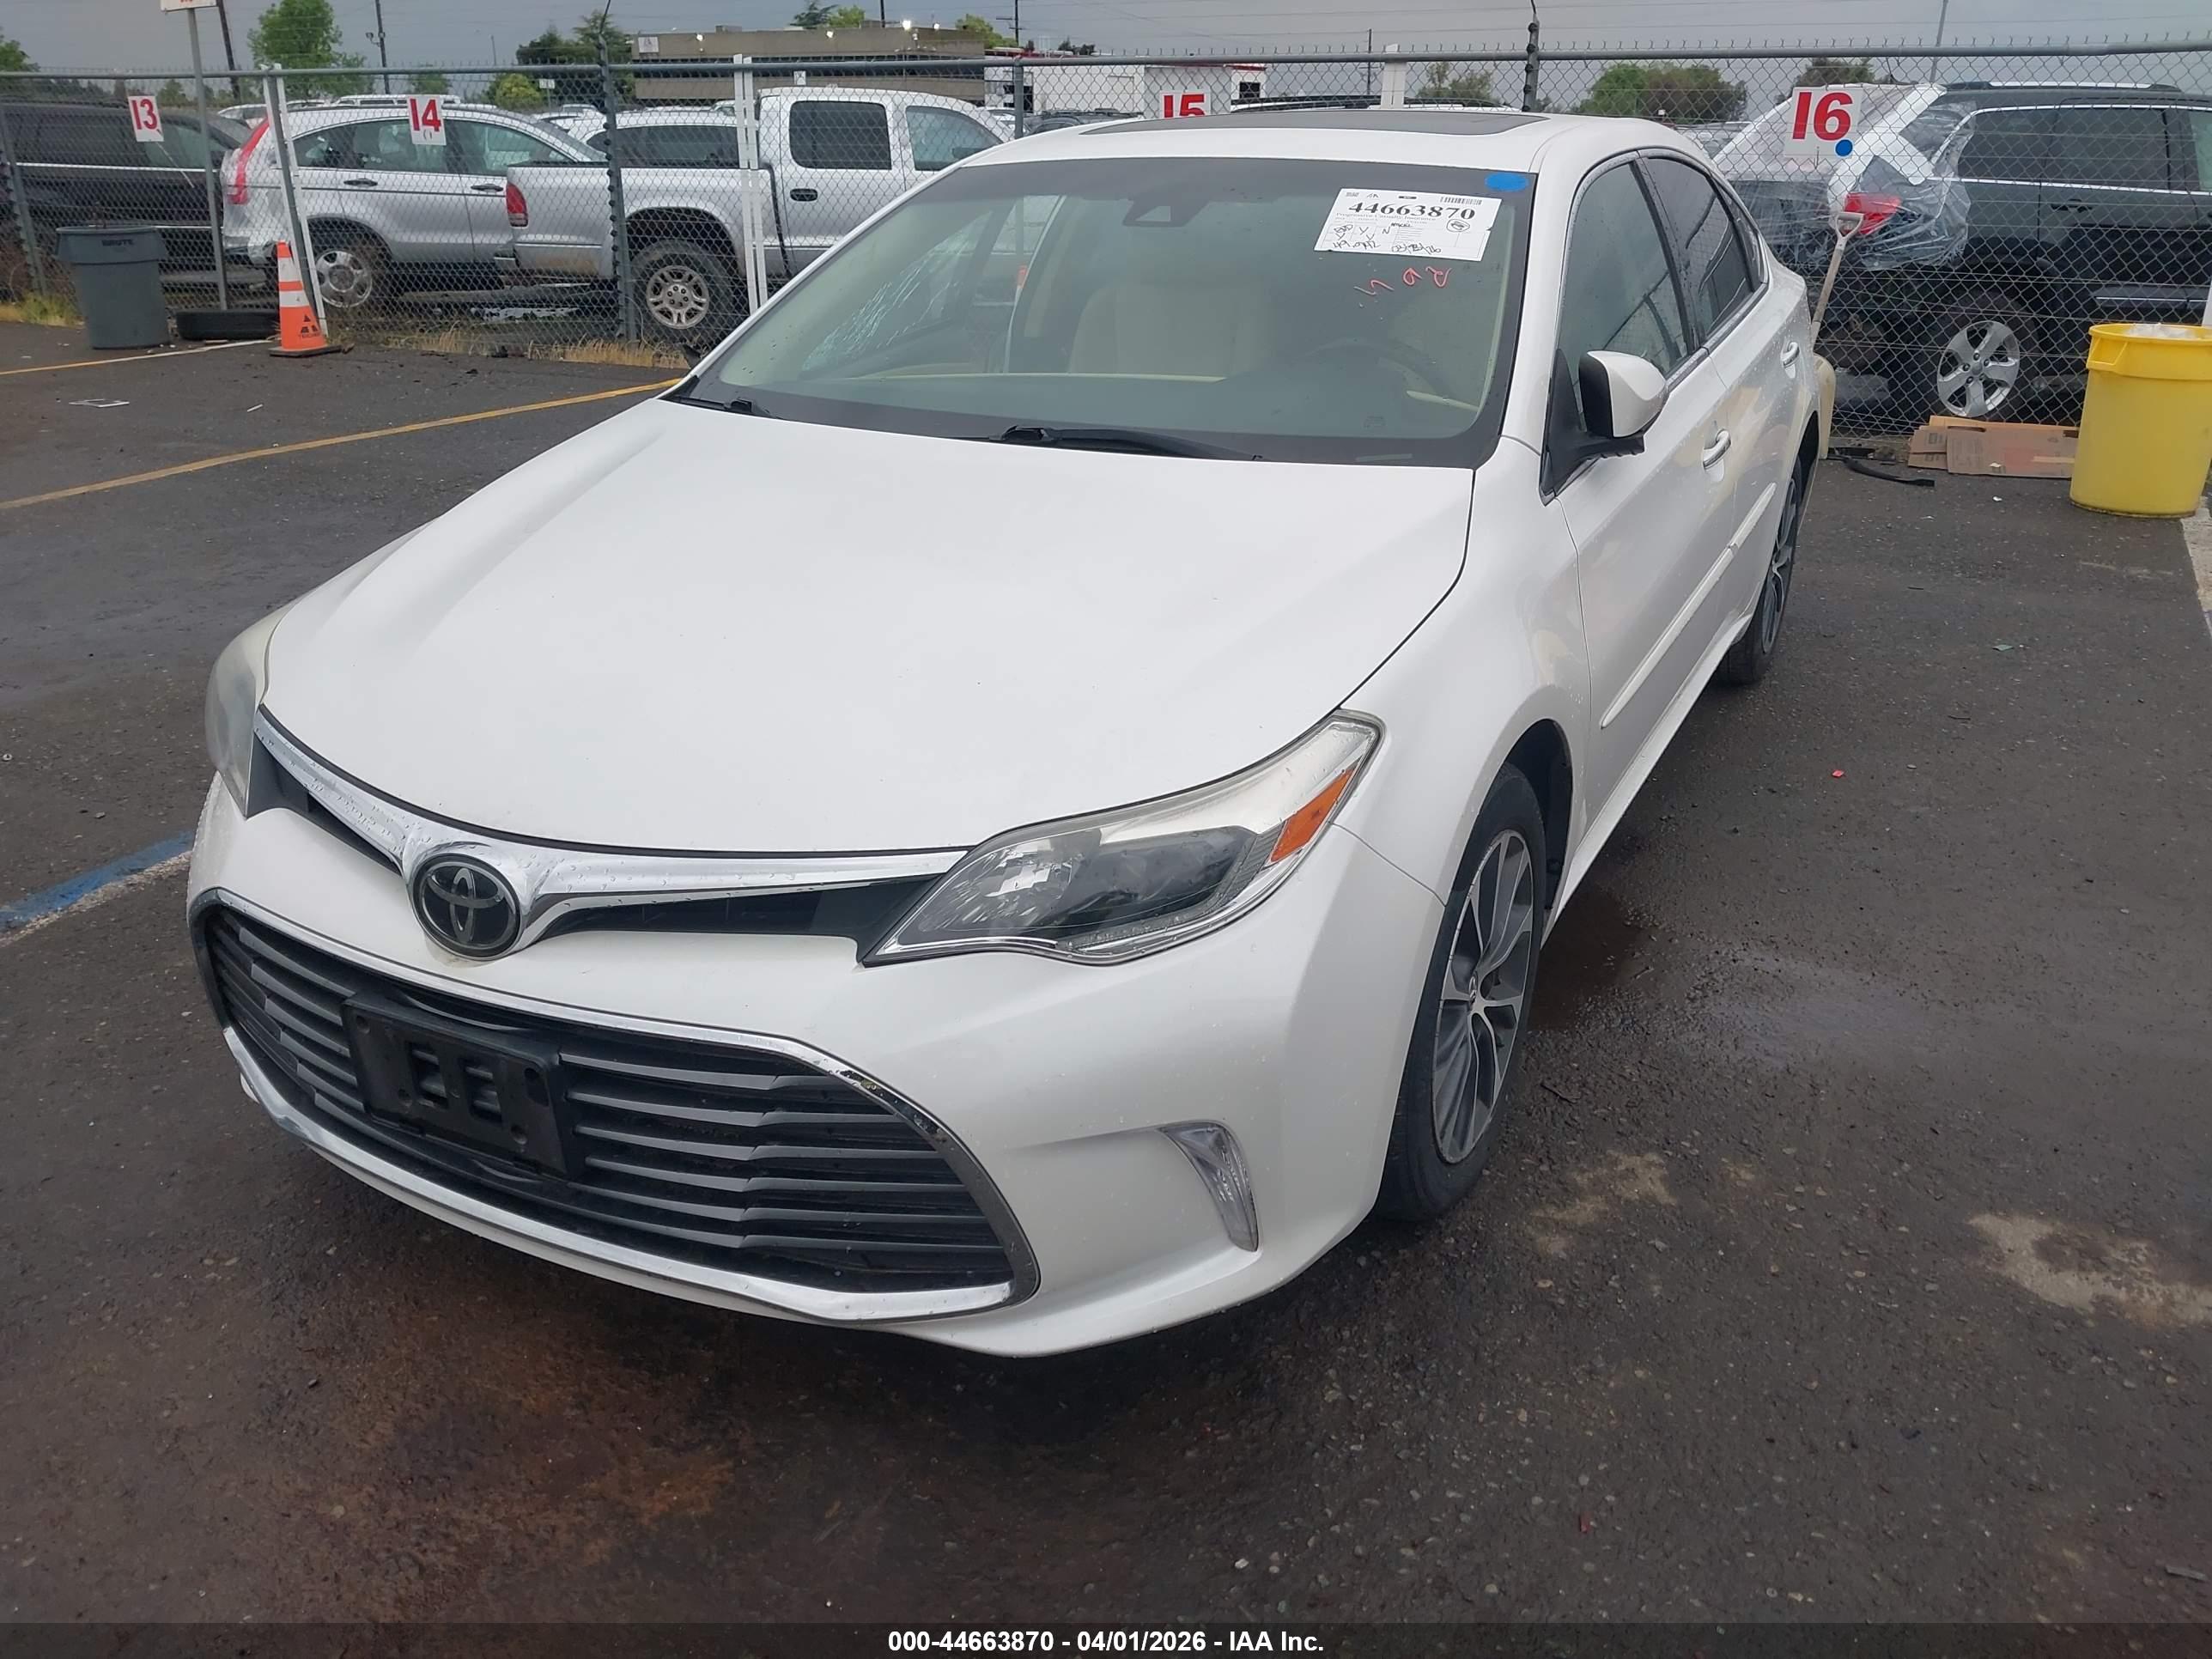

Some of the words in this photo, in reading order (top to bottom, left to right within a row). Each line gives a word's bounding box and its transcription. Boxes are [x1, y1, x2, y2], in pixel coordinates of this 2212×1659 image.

[131, 99, 158, 130] 13
[410, 98, 441, 131] 14
[1792, 92, 1853, 141] 16
[1348, 202, 1475, 220] 44663870
